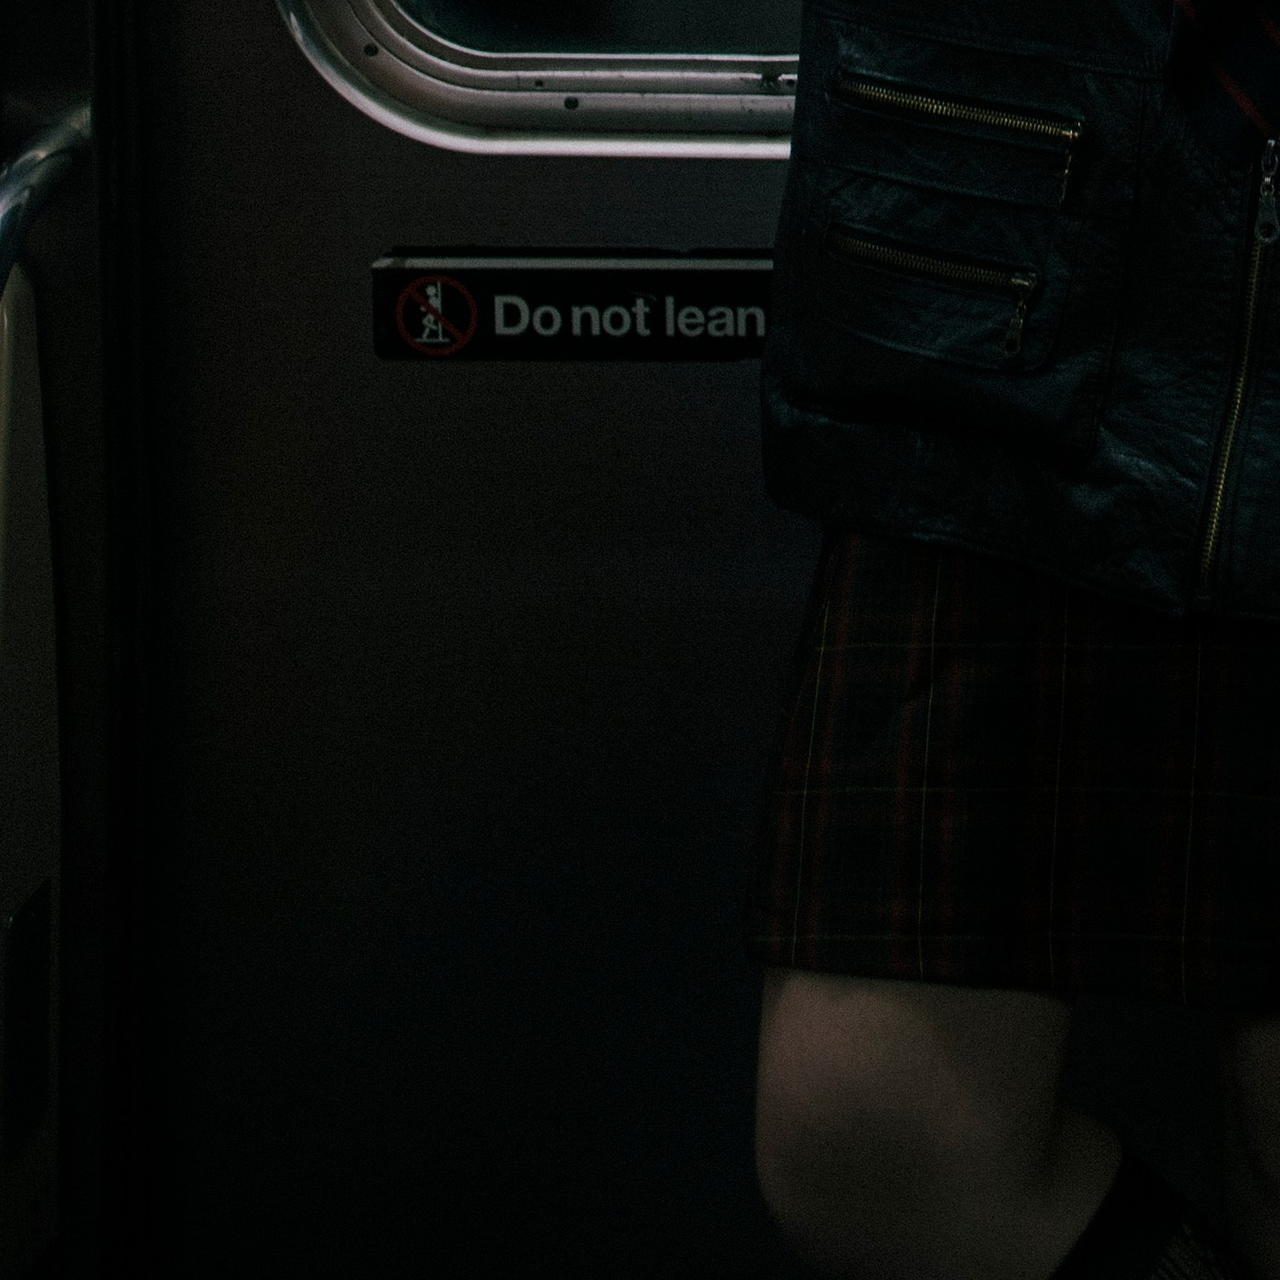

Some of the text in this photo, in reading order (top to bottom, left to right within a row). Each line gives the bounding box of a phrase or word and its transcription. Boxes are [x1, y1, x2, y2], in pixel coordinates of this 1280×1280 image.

[494, 295, 766, 337] Do not lean
